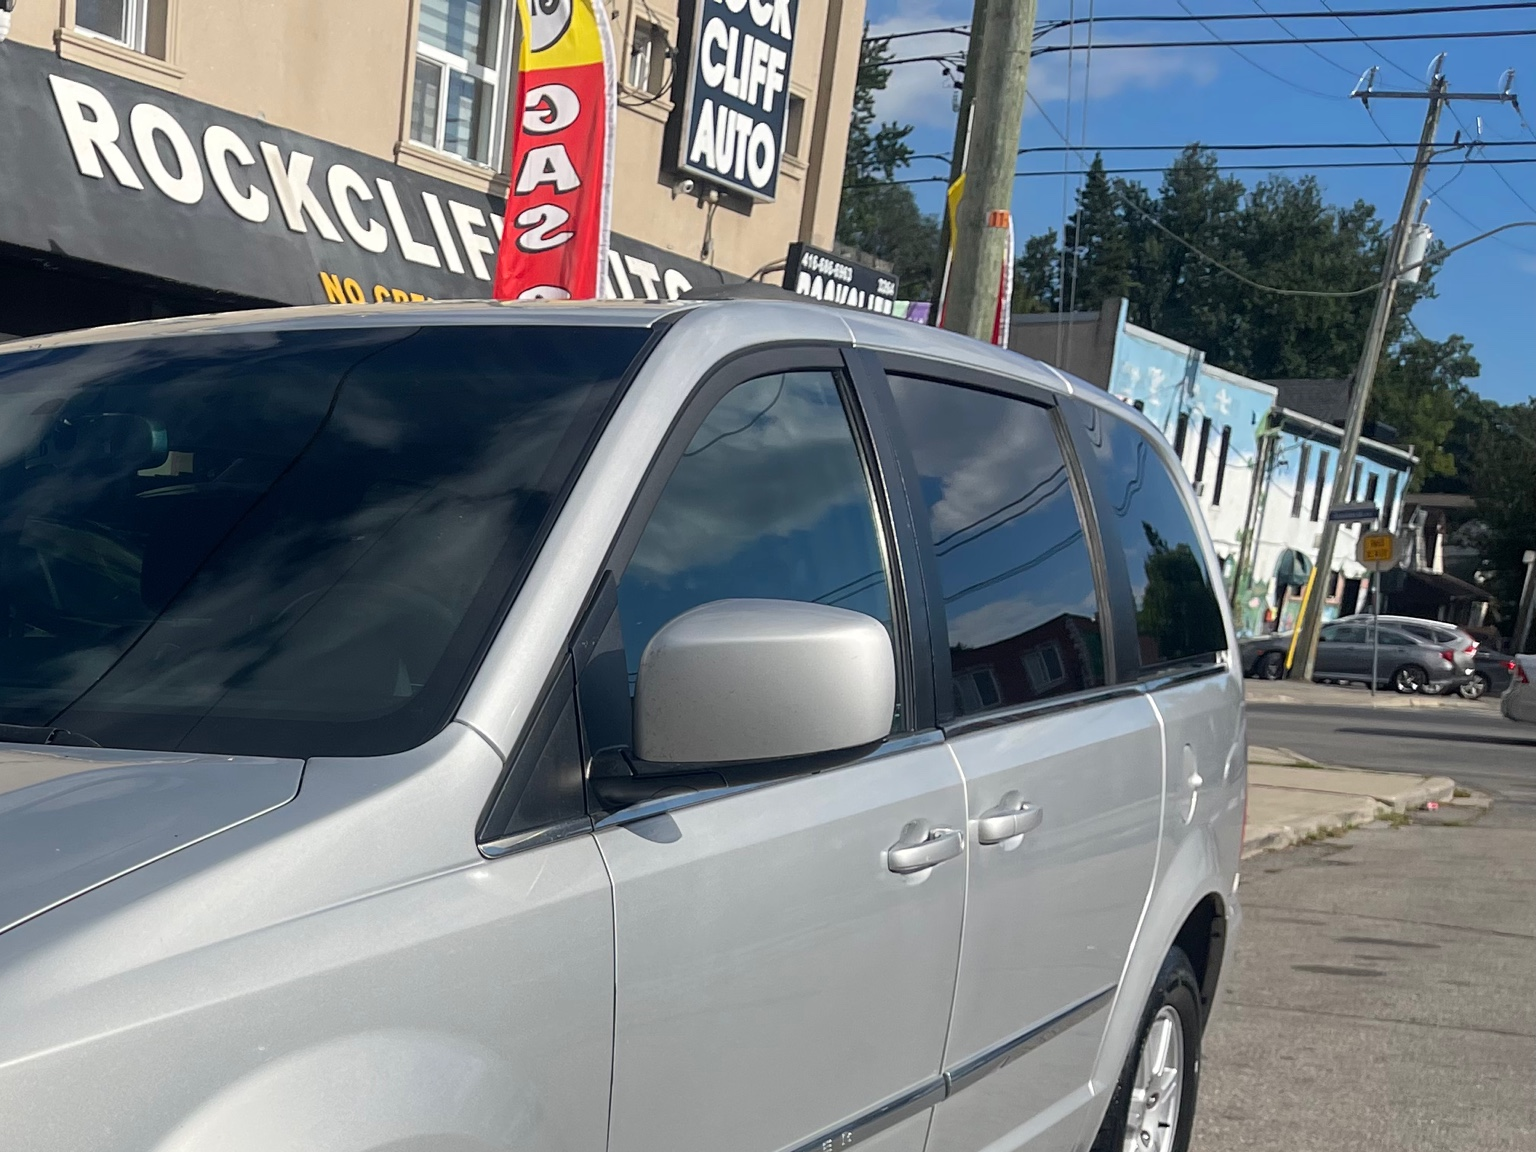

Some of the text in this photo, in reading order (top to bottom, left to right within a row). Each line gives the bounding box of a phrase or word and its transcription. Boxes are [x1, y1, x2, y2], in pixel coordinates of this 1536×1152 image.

[701, 17, 787, 113] CLIFF
[48, 73, 504, 281] ROCKCLIF
[690, 98, 775, 188] AUTO
[320, 271, 365, 303] NO
